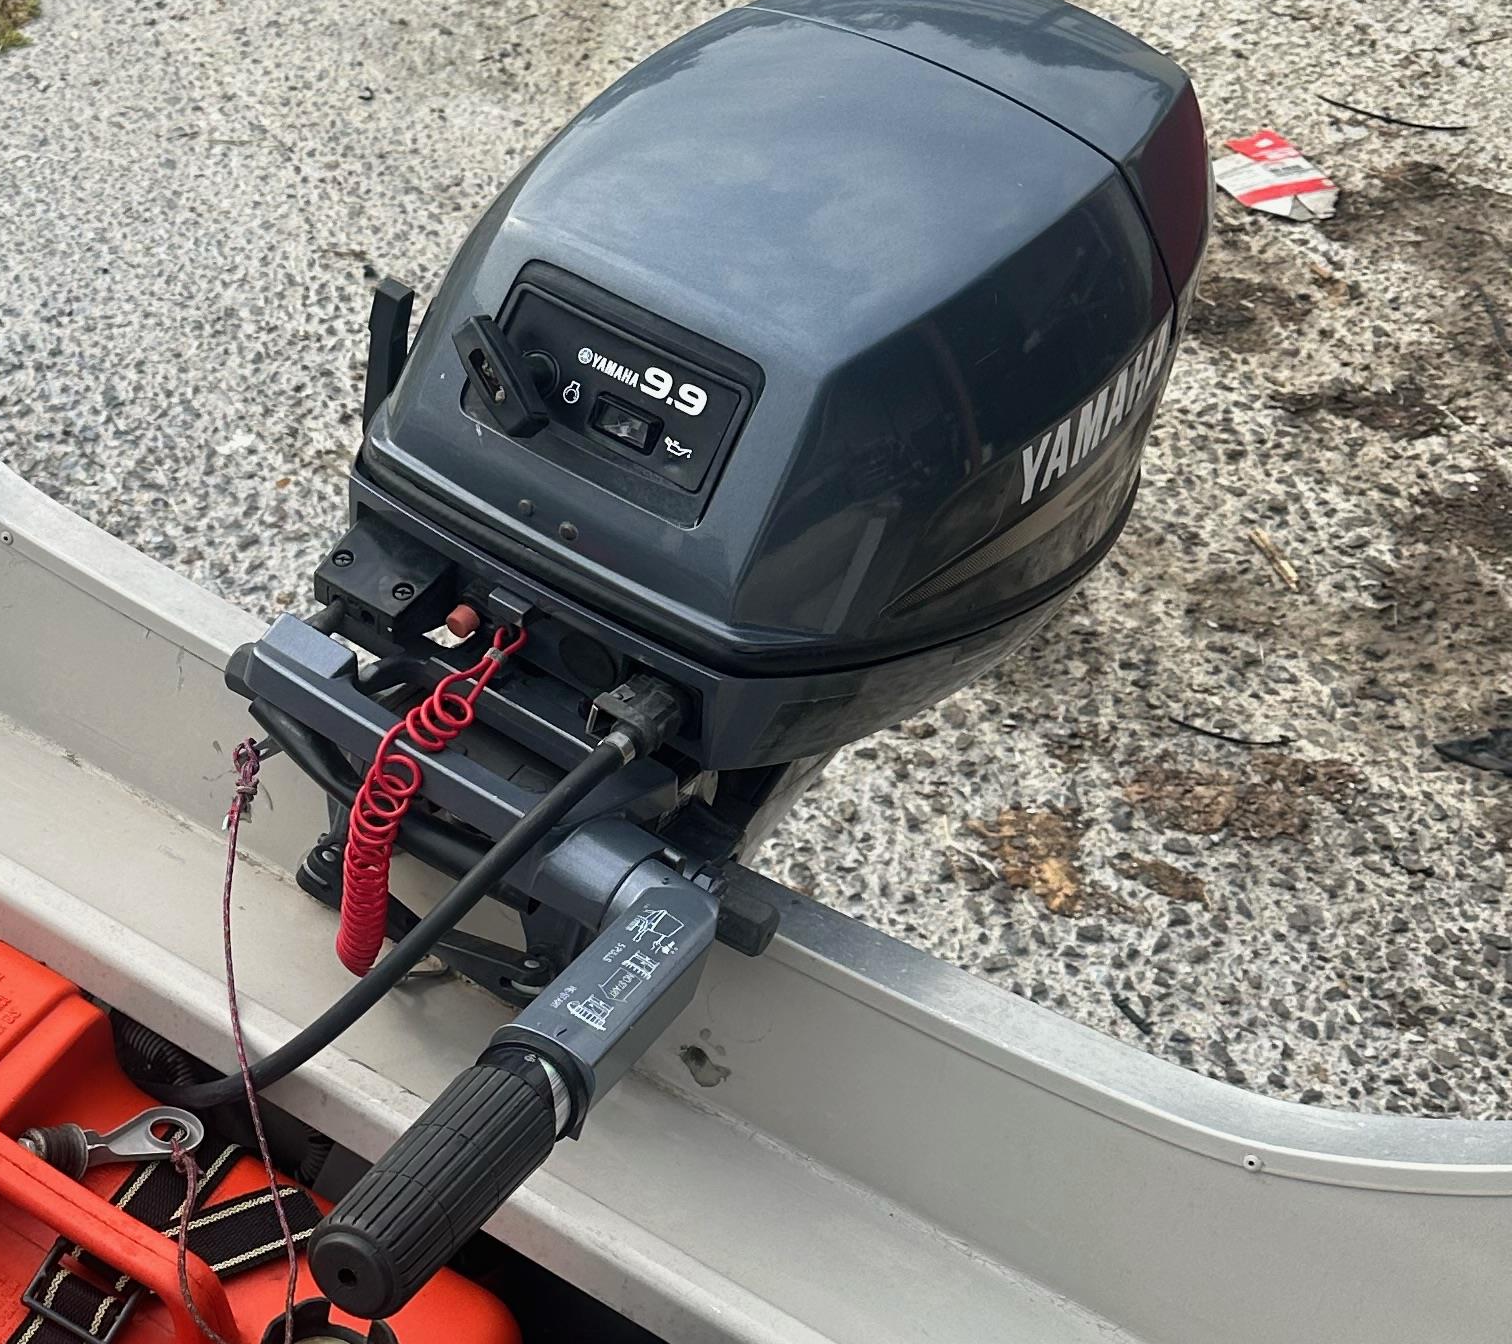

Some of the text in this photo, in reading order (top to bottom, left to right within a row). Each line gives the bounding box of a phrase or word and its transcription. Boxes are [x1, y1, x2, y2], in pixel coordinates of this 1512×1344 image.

[591, 352, 708, 416] YAMAHA 9.9
[1021, 319, 1169, 505] YAMAHA
